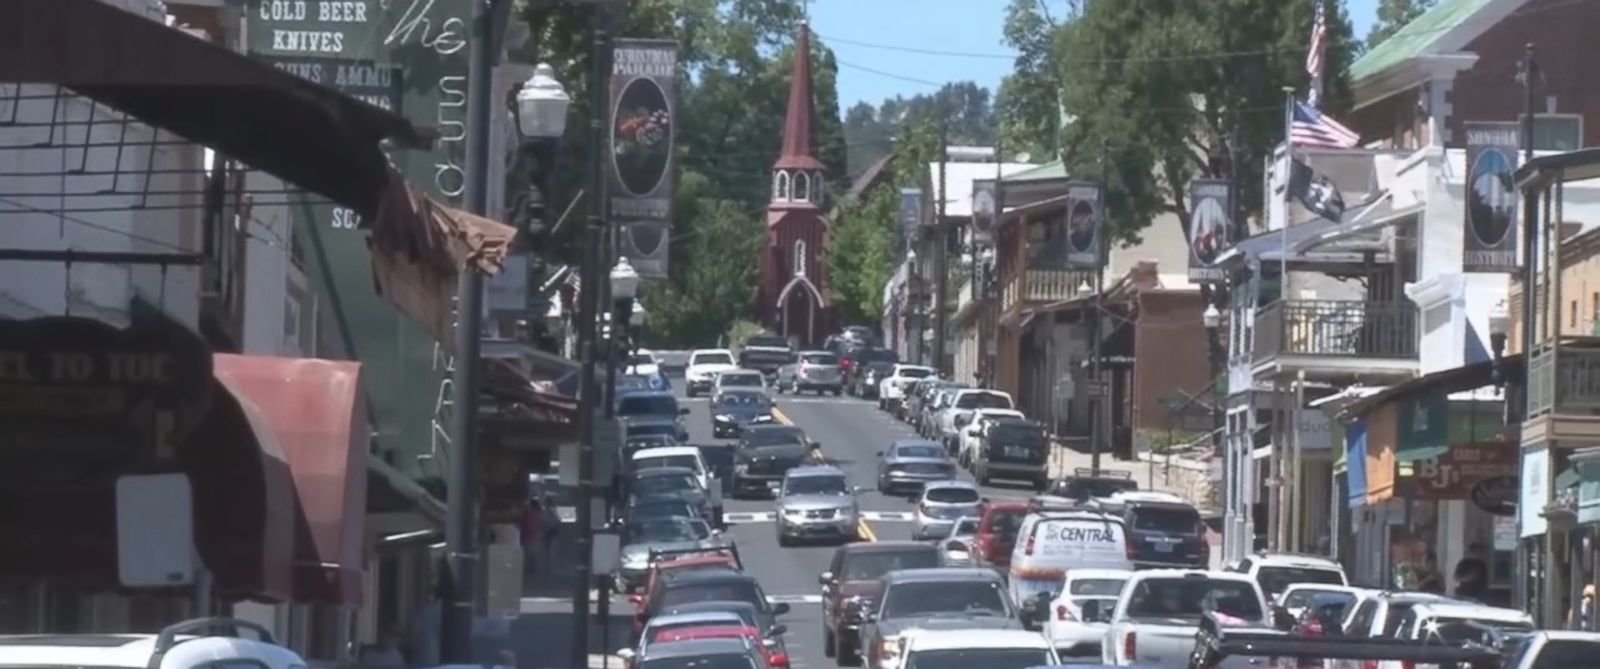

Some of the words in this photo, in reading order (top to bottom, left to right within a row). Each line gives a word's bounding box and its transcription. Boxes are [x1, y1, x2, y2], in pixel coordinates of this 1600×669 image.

[260, 1, 306, 21] COLD
[318, 2, 367, 22] BEER
[272, 29, 344, 52] KNIVES
[613, 62, 675, 76] PARADE
[1466, 128, 1518, 146] SONORA
[1465, 250, 1515, 267] HISTORY
[50, 352, 93, 382] TO
[1060, 527, 1117, 543] CENTRAL
